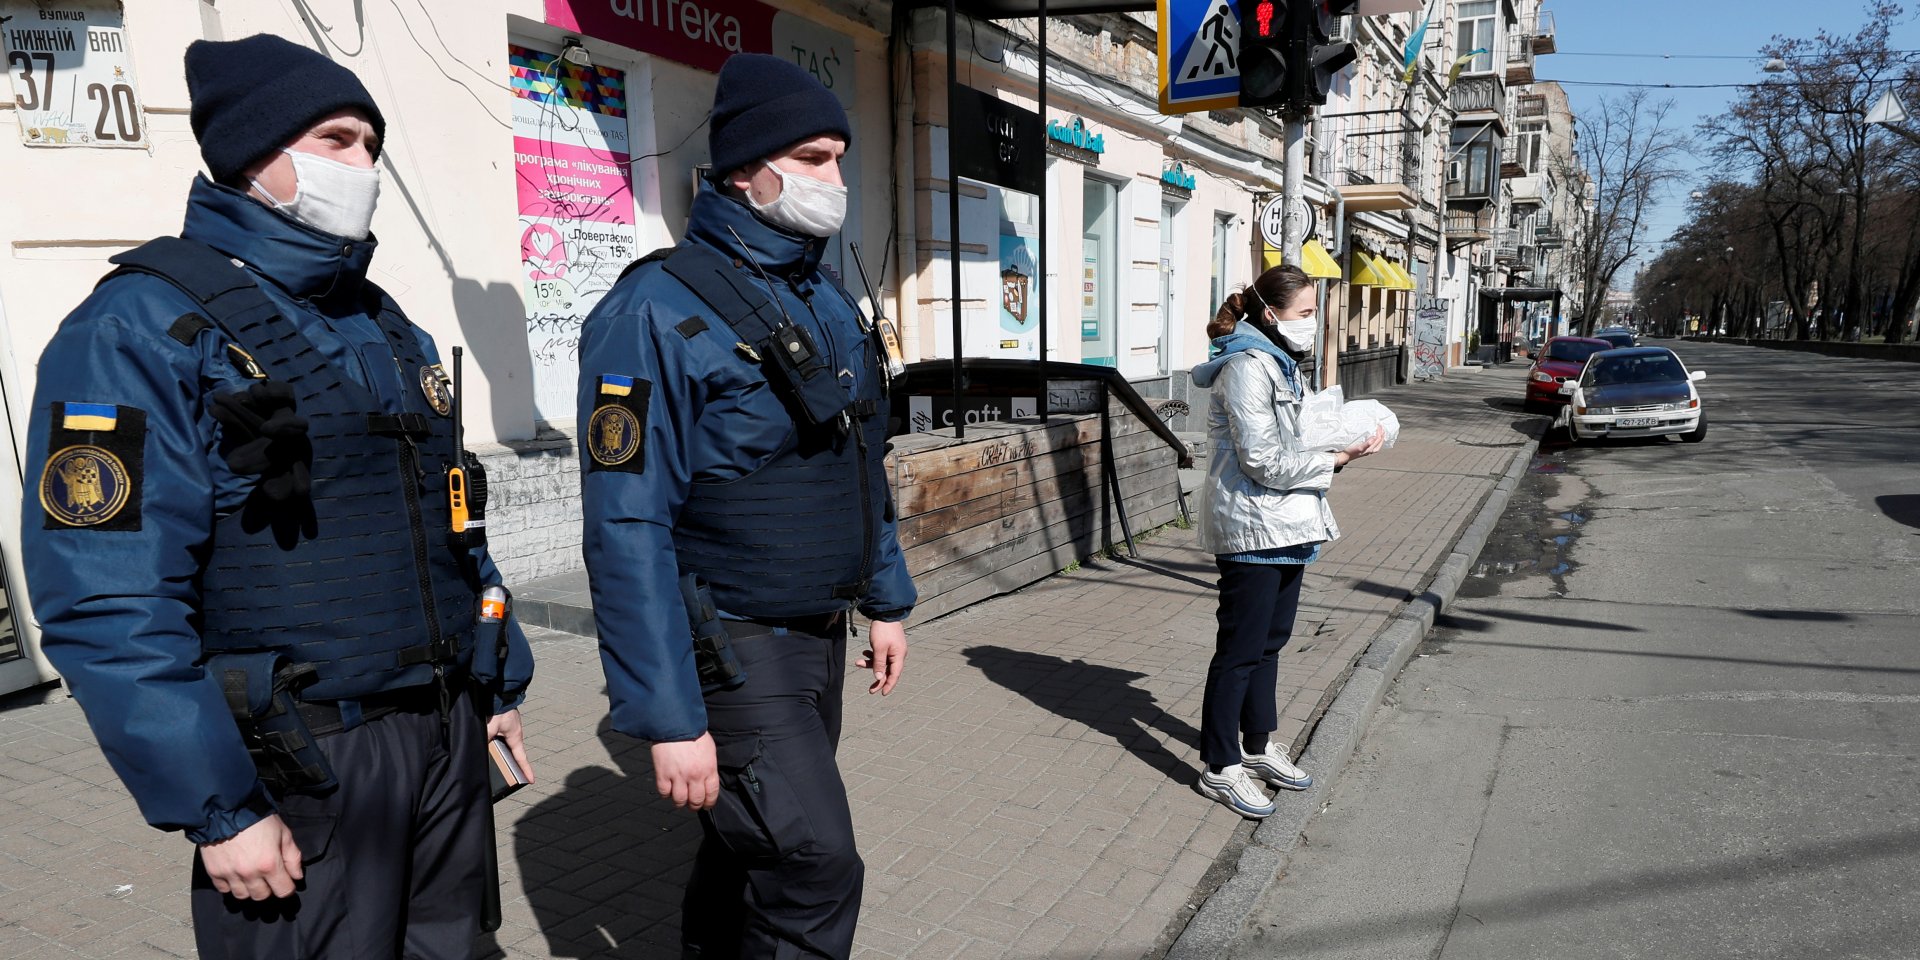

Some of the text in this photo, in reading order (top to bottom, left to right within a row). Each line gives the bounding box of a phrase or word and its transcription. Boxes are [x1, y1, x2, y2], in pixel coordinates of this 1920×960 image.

[610, 0, 743, 53] аптека
[10, 27, 123, 52] НИЖНІЙ ВАЛ
[791, 46, 834, 89] TAS
[8, 51, 55, 111] 37
[87, 83, 141, 142] 20
[514, 152, 628, 177] програма «лікування
[547, 172, 601, 189] хронічних
[610, 245, 633, 259] 15%
[534, 282, 562, 299] 15%
[942, 404, 1001, 427] caft
